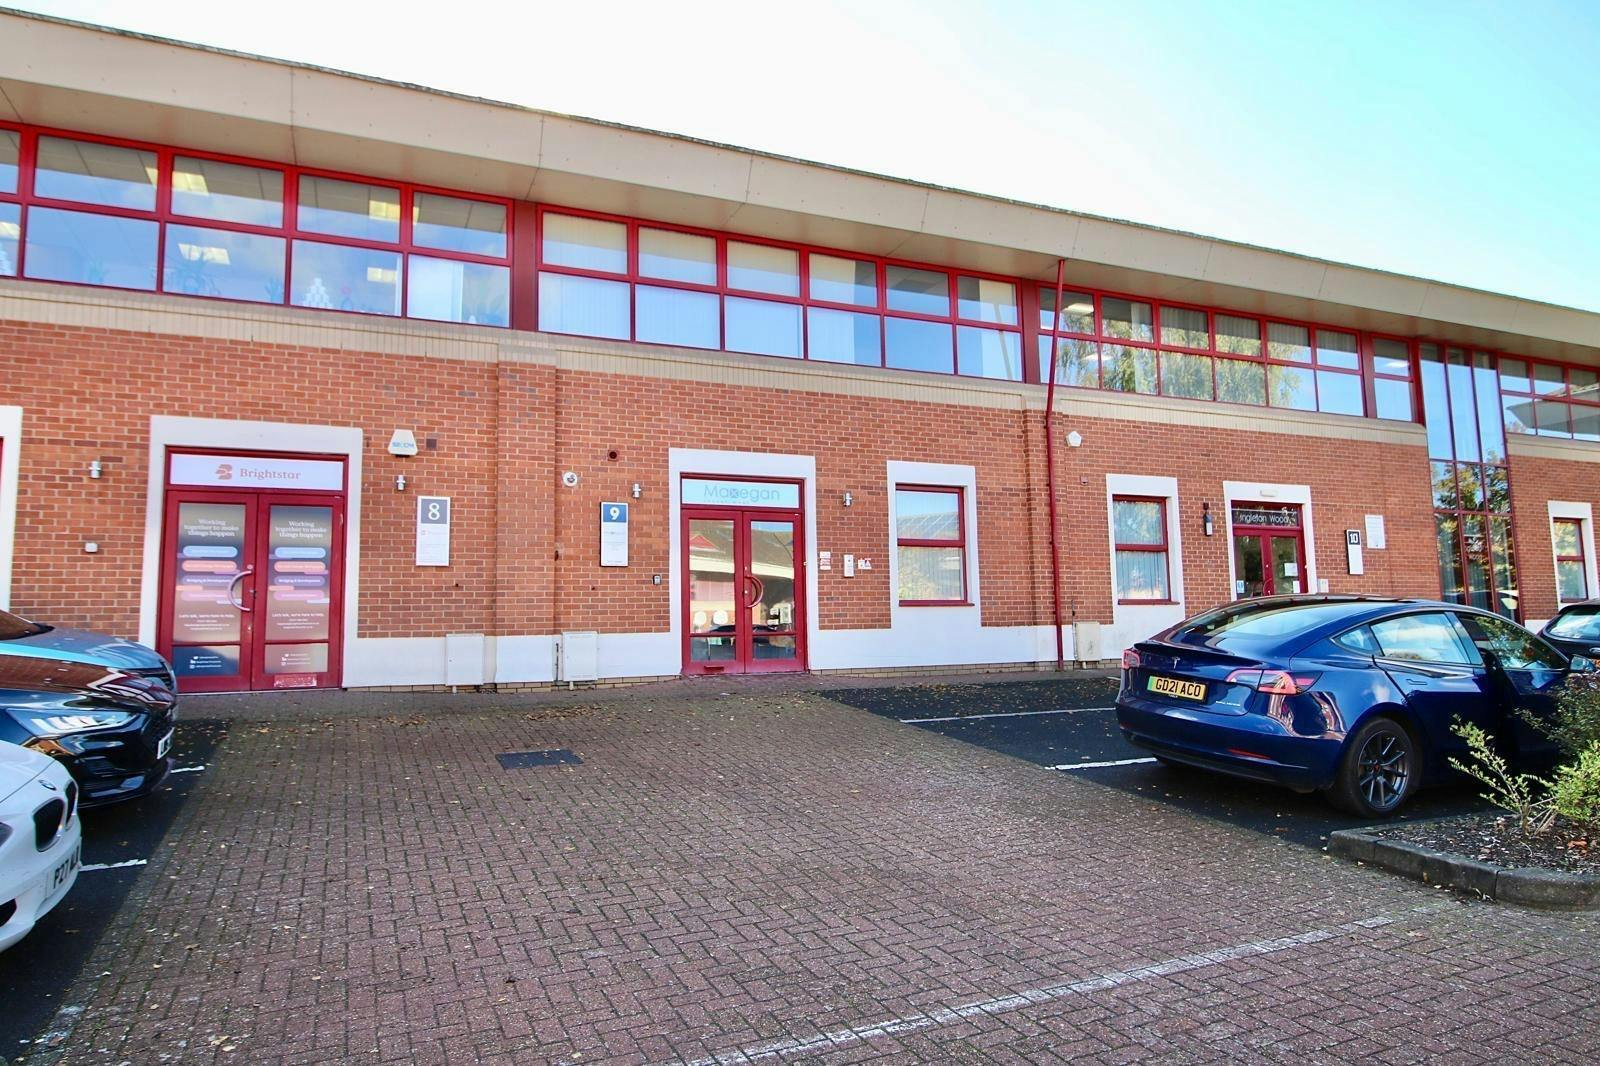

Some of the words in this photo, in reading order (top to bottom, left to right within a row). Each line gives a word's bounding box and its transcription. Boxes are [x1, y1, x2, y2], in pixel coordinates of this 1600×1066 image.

[239, 468, 301, 481] Brightstar
[428, 502, 440, 520] 8
[609, 506, 620, 521] 9
[1349, 533, 1359, 544] 10
[1155, 678, 1178, 693] GD21
[1180, 681, 1201, 697] ACO
